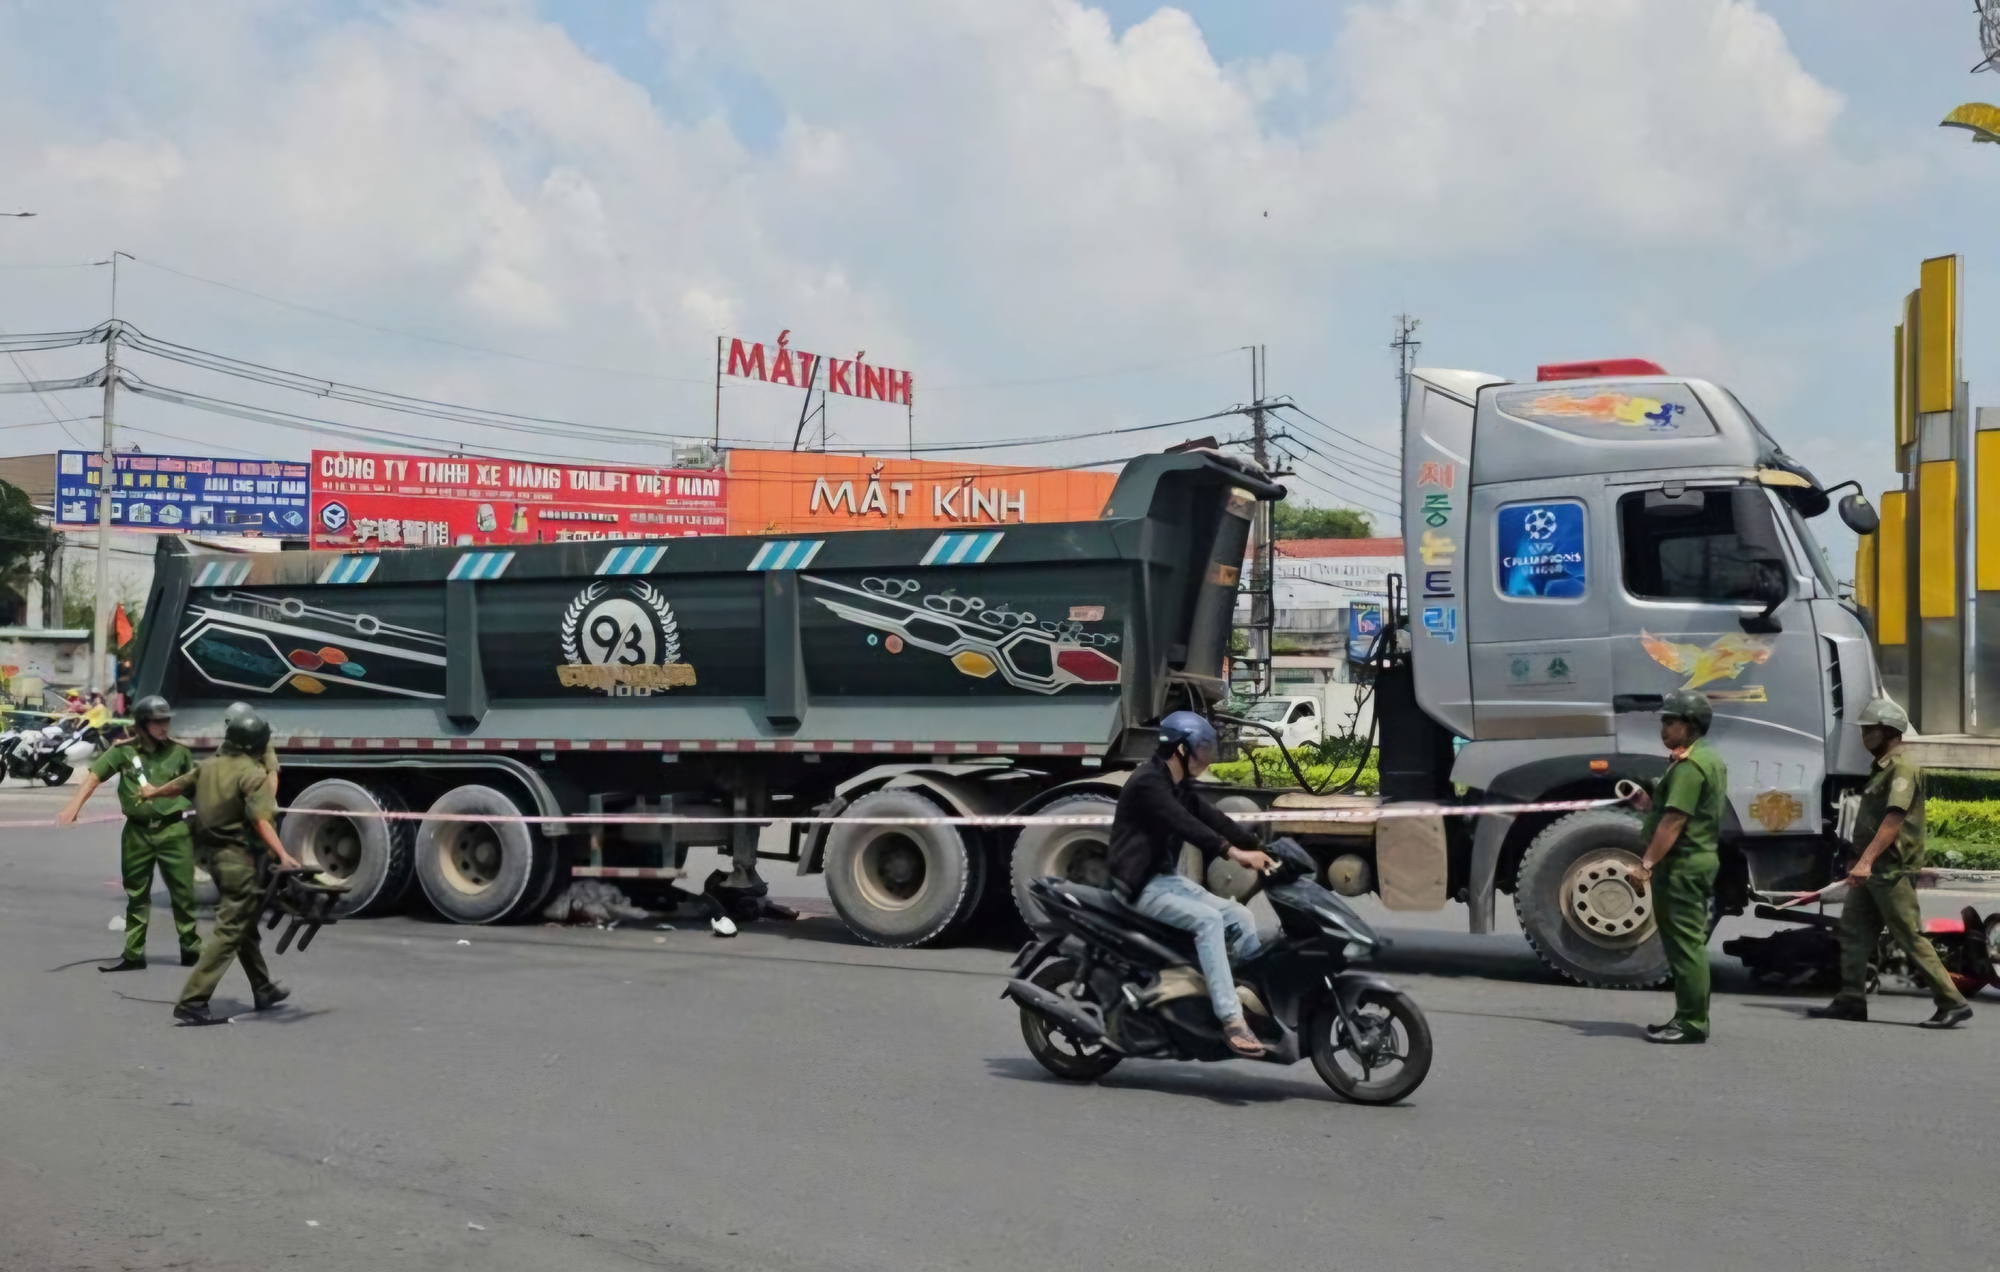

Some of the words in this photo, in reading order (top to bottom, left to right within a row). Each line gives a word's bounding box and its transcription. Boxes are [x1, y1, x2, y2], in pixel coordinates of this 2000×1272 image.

[829, 350, 912, 404] KÍNH
[383, 460, 409, 481] TY
[417, 462, 470, 484] TNHH
[476, 464, 502, 487] XE
[932, 476, 1026, 523] KÍNH
